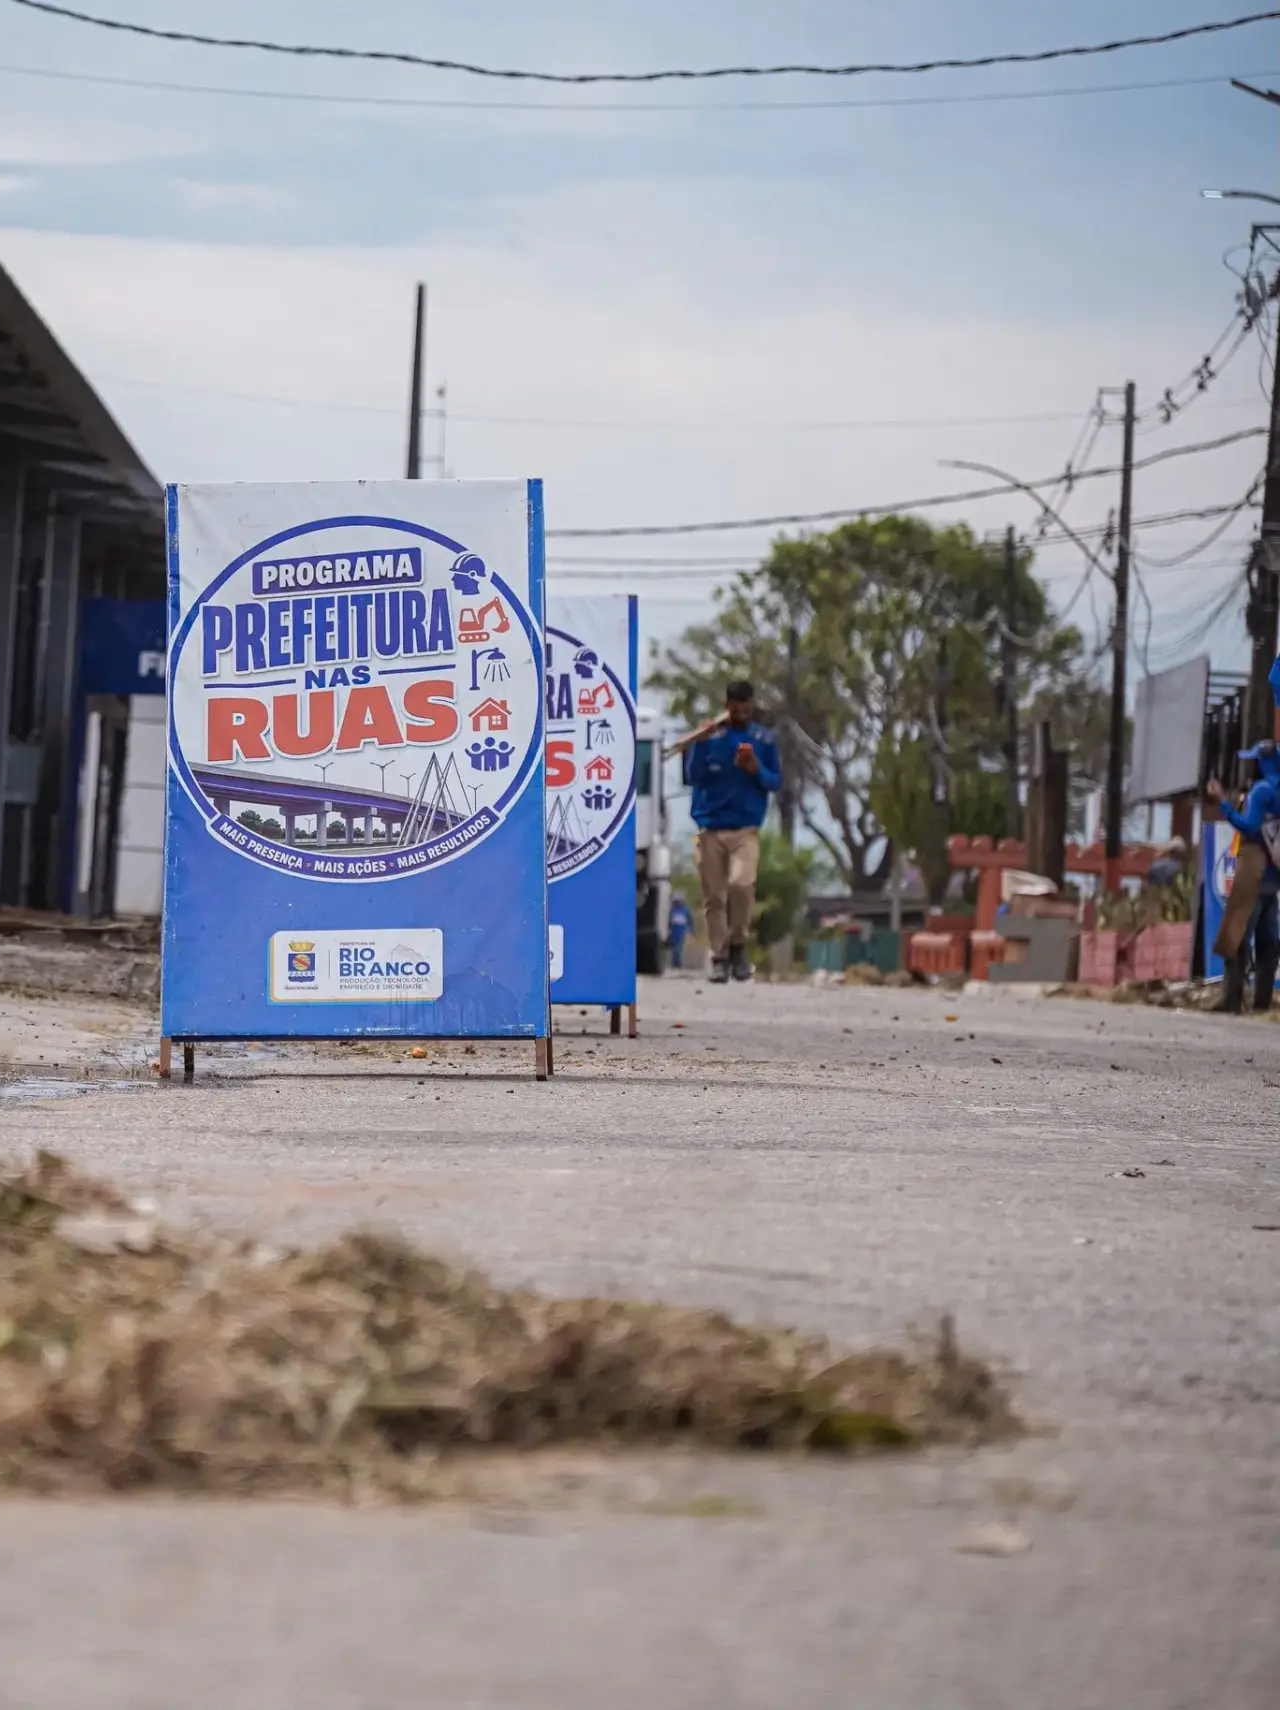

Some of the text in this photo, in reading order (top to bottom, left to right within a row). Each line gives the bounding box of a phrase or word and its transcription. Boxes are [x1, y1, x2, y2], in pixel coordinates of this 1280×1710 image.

[261, 553, 415, 590] PROGRAMA
[202, 588, 455, 676] PREFEITURA
[305, 665, 371, 690] NAS
[207, 680, 460, 763] RUAS
[219, 814, 491, 876] MAIS PRESENÇA MAIS AÇÕES MAIS RESULTADOS
[553, 842, 599, 876] RESULTADOS
[339, 948, 375, 962] RIO
[339, 962, 430, 976] BRANCO
